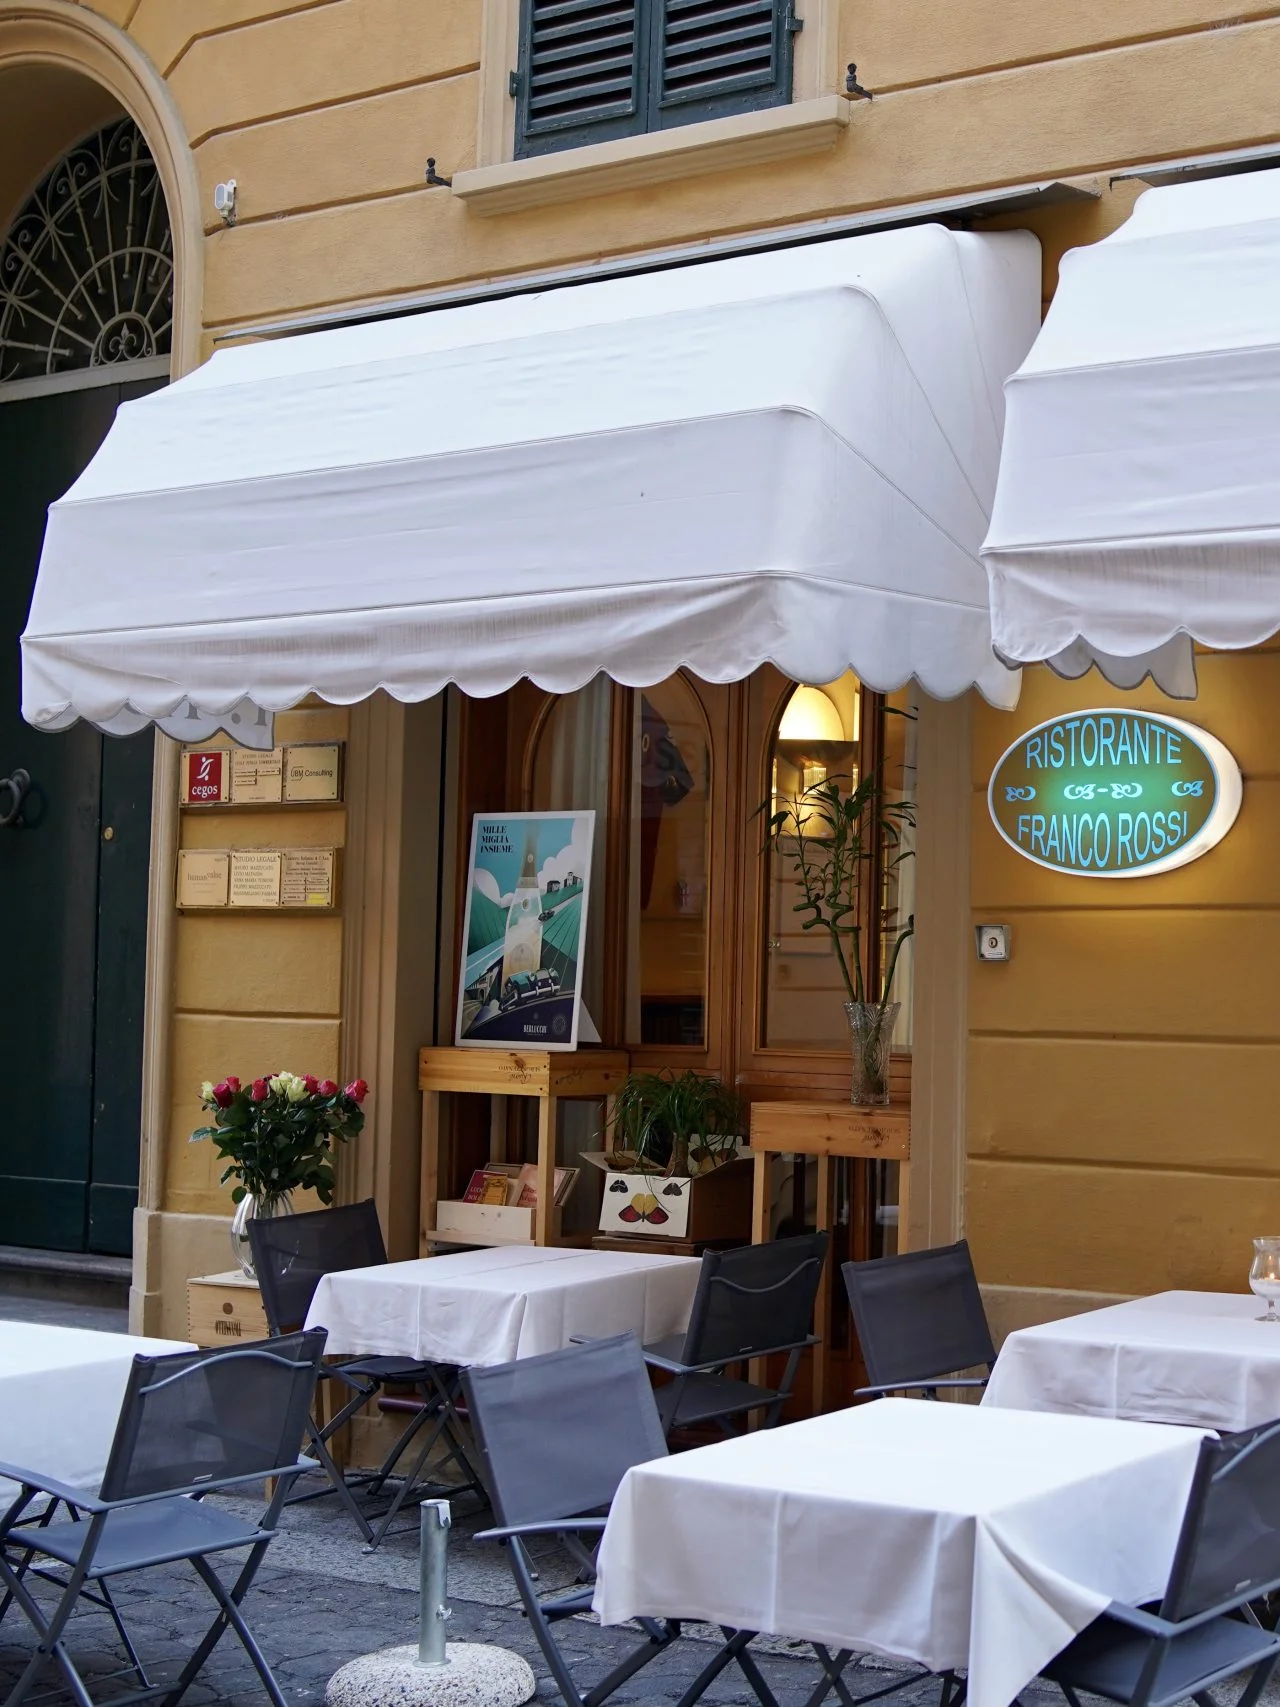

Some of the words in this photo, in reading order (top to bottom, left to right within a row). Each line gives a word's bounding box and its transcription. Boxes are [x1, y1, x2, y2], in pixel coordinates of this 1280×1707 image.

[1026, 717, 1182, 769] RISTORANTE
[305, 767, 333, 778] Consulting
[191, 784, 218, 798] cegos
[483, 825, 507, 834] MILLE
[482, 835, 509, 843] MIGLIA
[1017, 813, 1111, 868] FRANCO
[1117, 811, 1188, 866] ROSSI
[481, 844, 514, 853] INSIEME
